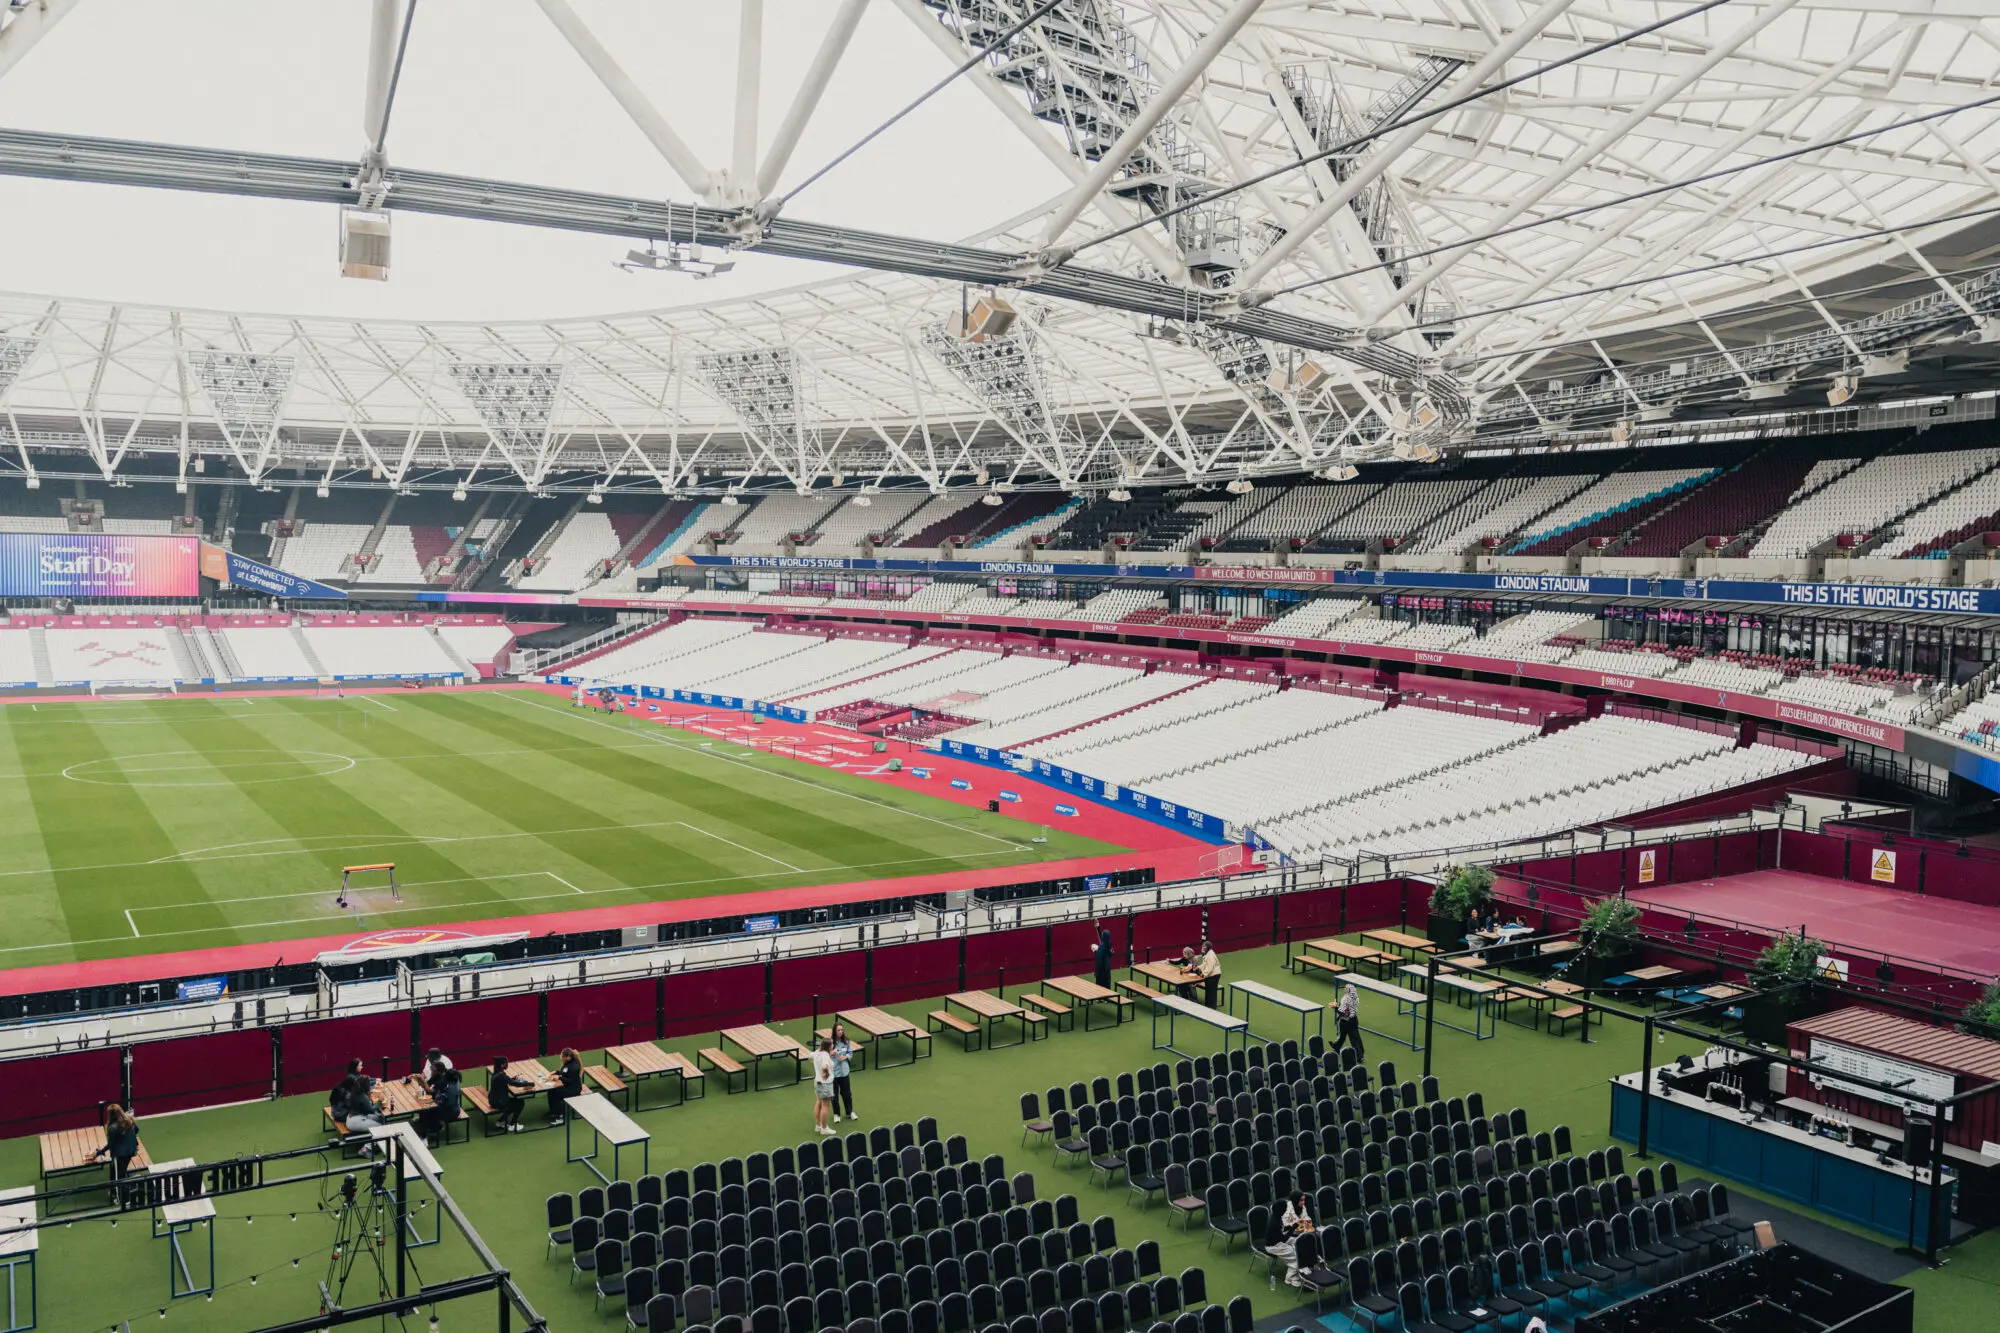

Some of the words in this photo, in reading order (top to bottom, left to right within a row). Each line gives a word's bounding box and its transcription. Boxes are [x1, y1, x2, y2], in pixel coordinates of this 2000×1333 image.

[41, 555, 92, 574] Staff
[94, 556, 135, 579] Day
[730, 556, 749, 566] THIS
[751, 557, 759, 566] IS
[761, 558, 777, 567] THE
[779, 558, 817, 568] WORLD'S
[817, 559, 844, 568] STAGE
[980, 562, 1015, 573] LONDON
[1016, 563, 1054, 574] STADIUM
[232, 559, 251, 572] STAY
[251, 565, 295, 586] CONNECTED
[1211, 569, 1245, 579] WELCOME
[1246, 569, 1255, 579] TO
[1256, 570, 1274, 580] WEST
[1274, 570, 1290, 581] HAM
[1290, 571, 1316, 581] UNITED
[1495, 576, 1539, 590] LONDON
[1540, 578, 1590, 592] STADIUM
[1782, 585, 1813, 602] THIS
[1816, 586, 1829, 603] IS
[1831, 587, 1859, 604] THE
[1862, 588, 1929, 609] WORLD'S
[1931, 590, 1980, 611] STAGE
[1433, 655, 1443, 663] CUP
[1616, 678, 1623, 687] FA
[1623, 679, 1635, 689] CUP
[1780, 706, 1793, 718] 2023
[1793, 708, 1807, 722] UEFA
[1807, 711, 1828, 727] EUROPA
[1828, 716, 1863, 735] CONFERENCE
[1863, 725, 1884, 741] LEAGUE
